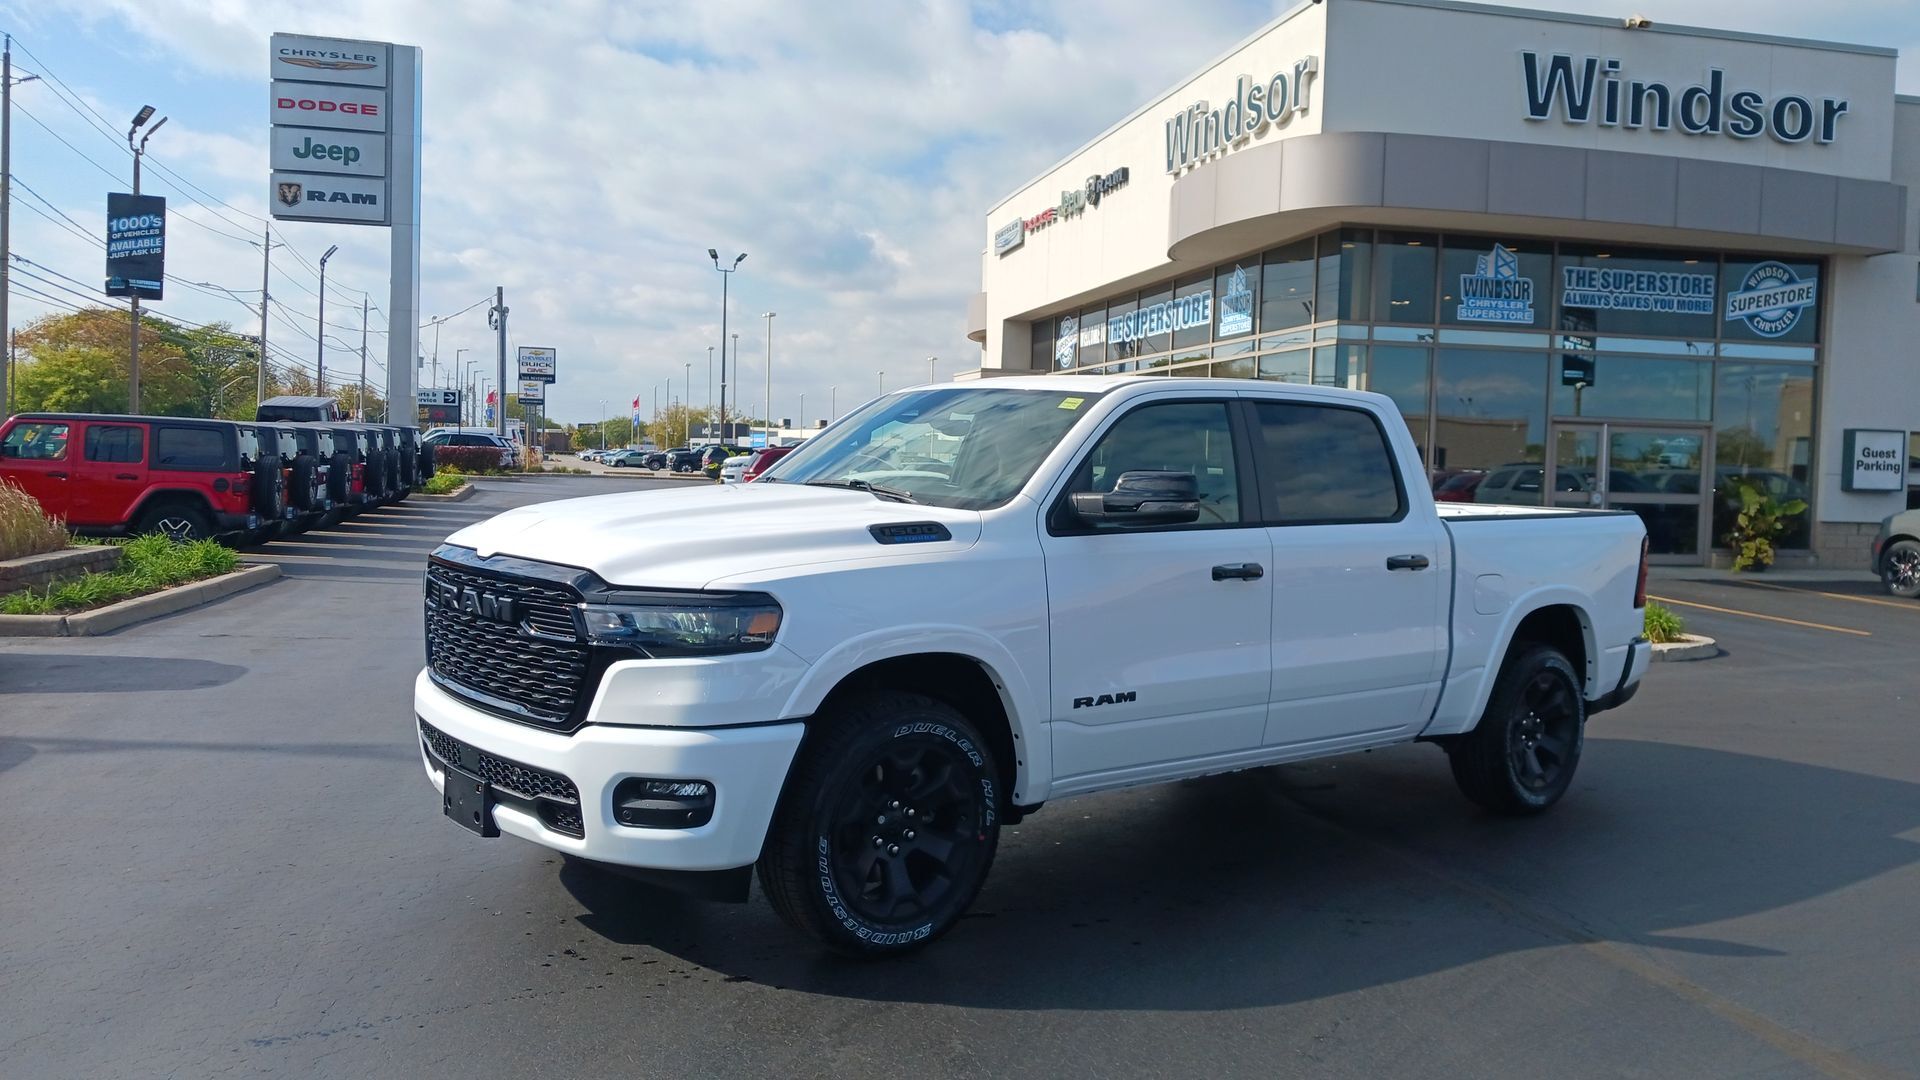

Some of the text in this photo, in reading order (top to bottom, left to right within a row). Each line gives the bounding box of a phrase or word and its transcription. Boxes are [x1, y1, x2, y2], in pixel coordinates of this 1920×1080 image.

[280, 48, 377, 63] CHRYSLER
[278, 98, 378, 116] DODGE
[1522, 50, 1849, 145] Windsor
[1164, 55, 1317, 175] Windsor
[292, 137, 360, 166] Jeep
[1095, 167, 1129, 193] RAM
[306, 190, 377, 206] RAM
[110, 216, 162, 231] 1000's
[123, 229, 160, 238] VEHICLES
[109, 250, 130, 259] JUST
[131, 248, 148, 256] ASK
[110, 238, 162, 252] AVAILABLE
[1565, 268, 1713, 296] THE SUPERSTORE
[1748, 266, 1790, 288] WINDSOR
[1463, 277, 1530, 300] WINDSOR
[1730, 286, 1813, 313] SUPERSTORE
[1468, 299, 1524, 309] CHRYSLER
[1564, 291, 1712, 313] ALWAYS SAVES YOU MORE!
[1108, 318, 1123, 343] THE
[1124, 293, 1212, 342] SUPERSTORE
[1461, 308, 1532, 320] SUPERSTORE
[1753, 310, 1795, 333] CHRYSLER
[1862, 446, 1897, 459] Guest
[1856, 459, 1901, 474] Parking
[439, 581, 514, 622] RAM
[1073, 691, 1137, 709] RAM
[893, 722, 984, 768] DUELER
[818, 835, 932, 945] BRIDGESTONE
